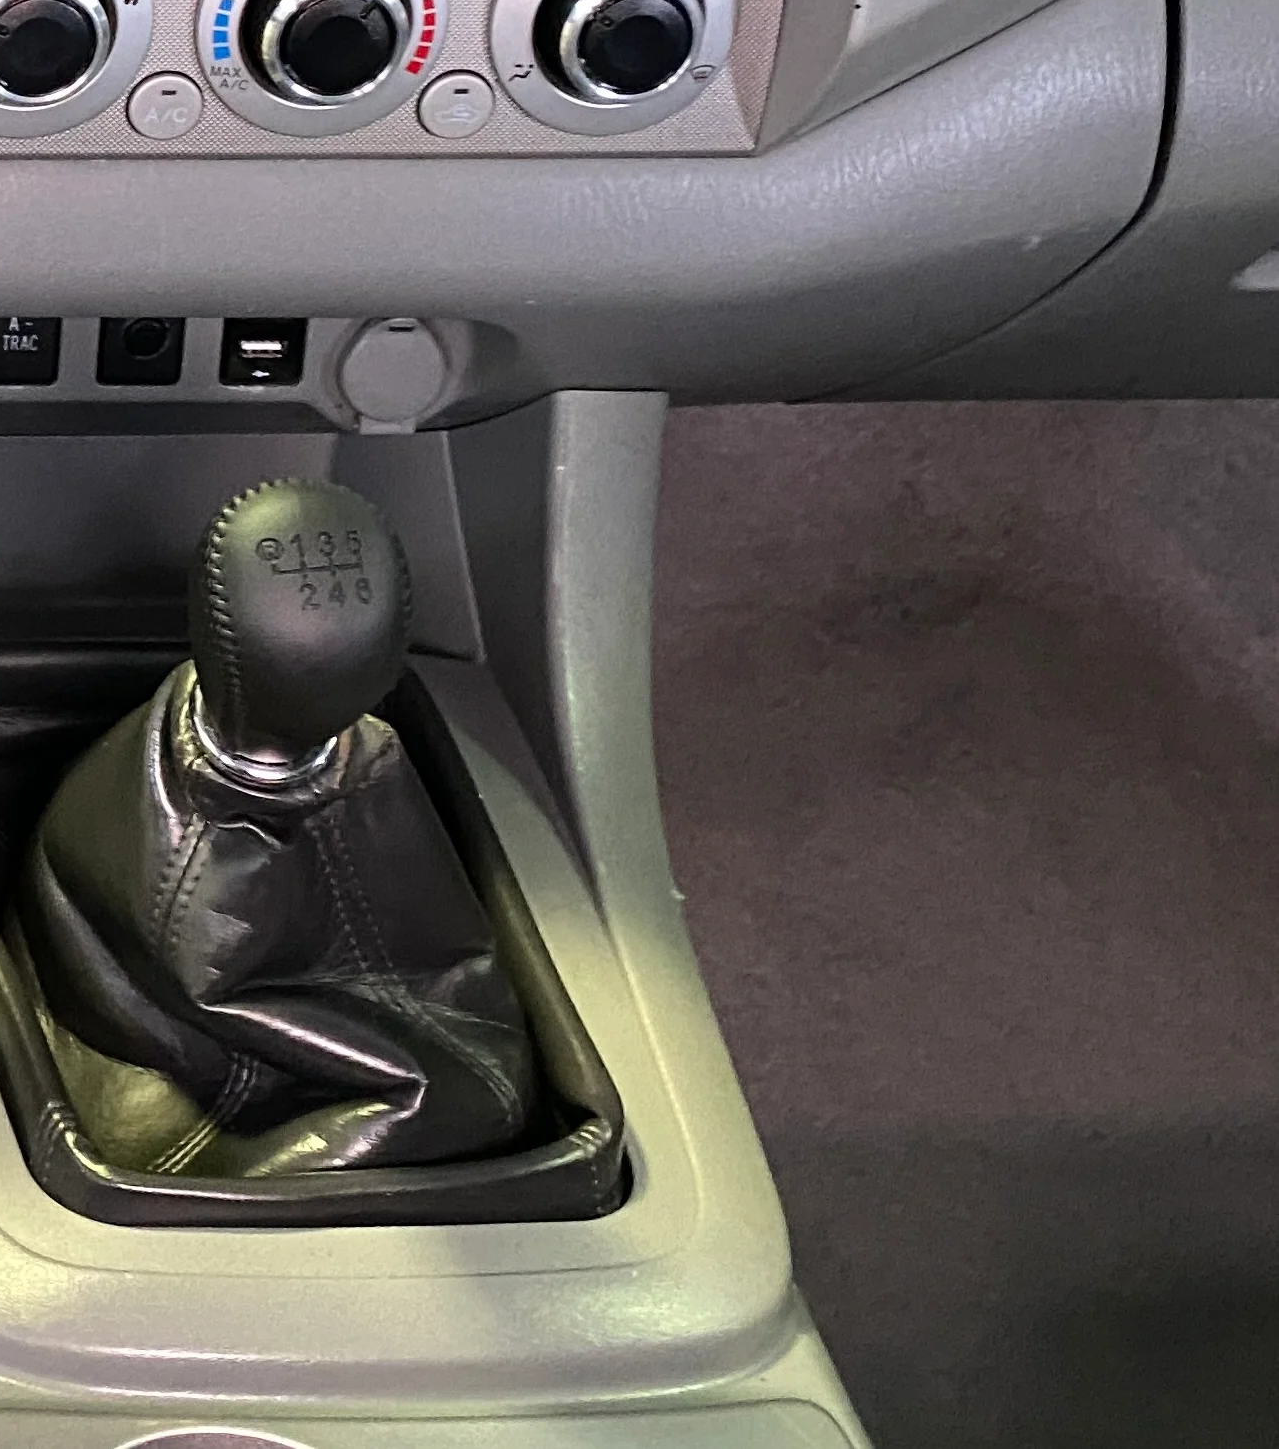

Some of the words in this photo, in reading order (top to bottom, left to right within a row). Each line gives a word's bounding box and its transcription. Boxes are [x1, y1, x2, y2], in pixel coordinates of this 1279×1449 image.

[209, 65, 242, 78] MAX
[219, 78, 249, 91] A/C
[143, 106, 188, 124] A/C
[2, 334, 39, 351] TRAC
[299, 583, 321, 611] 2
